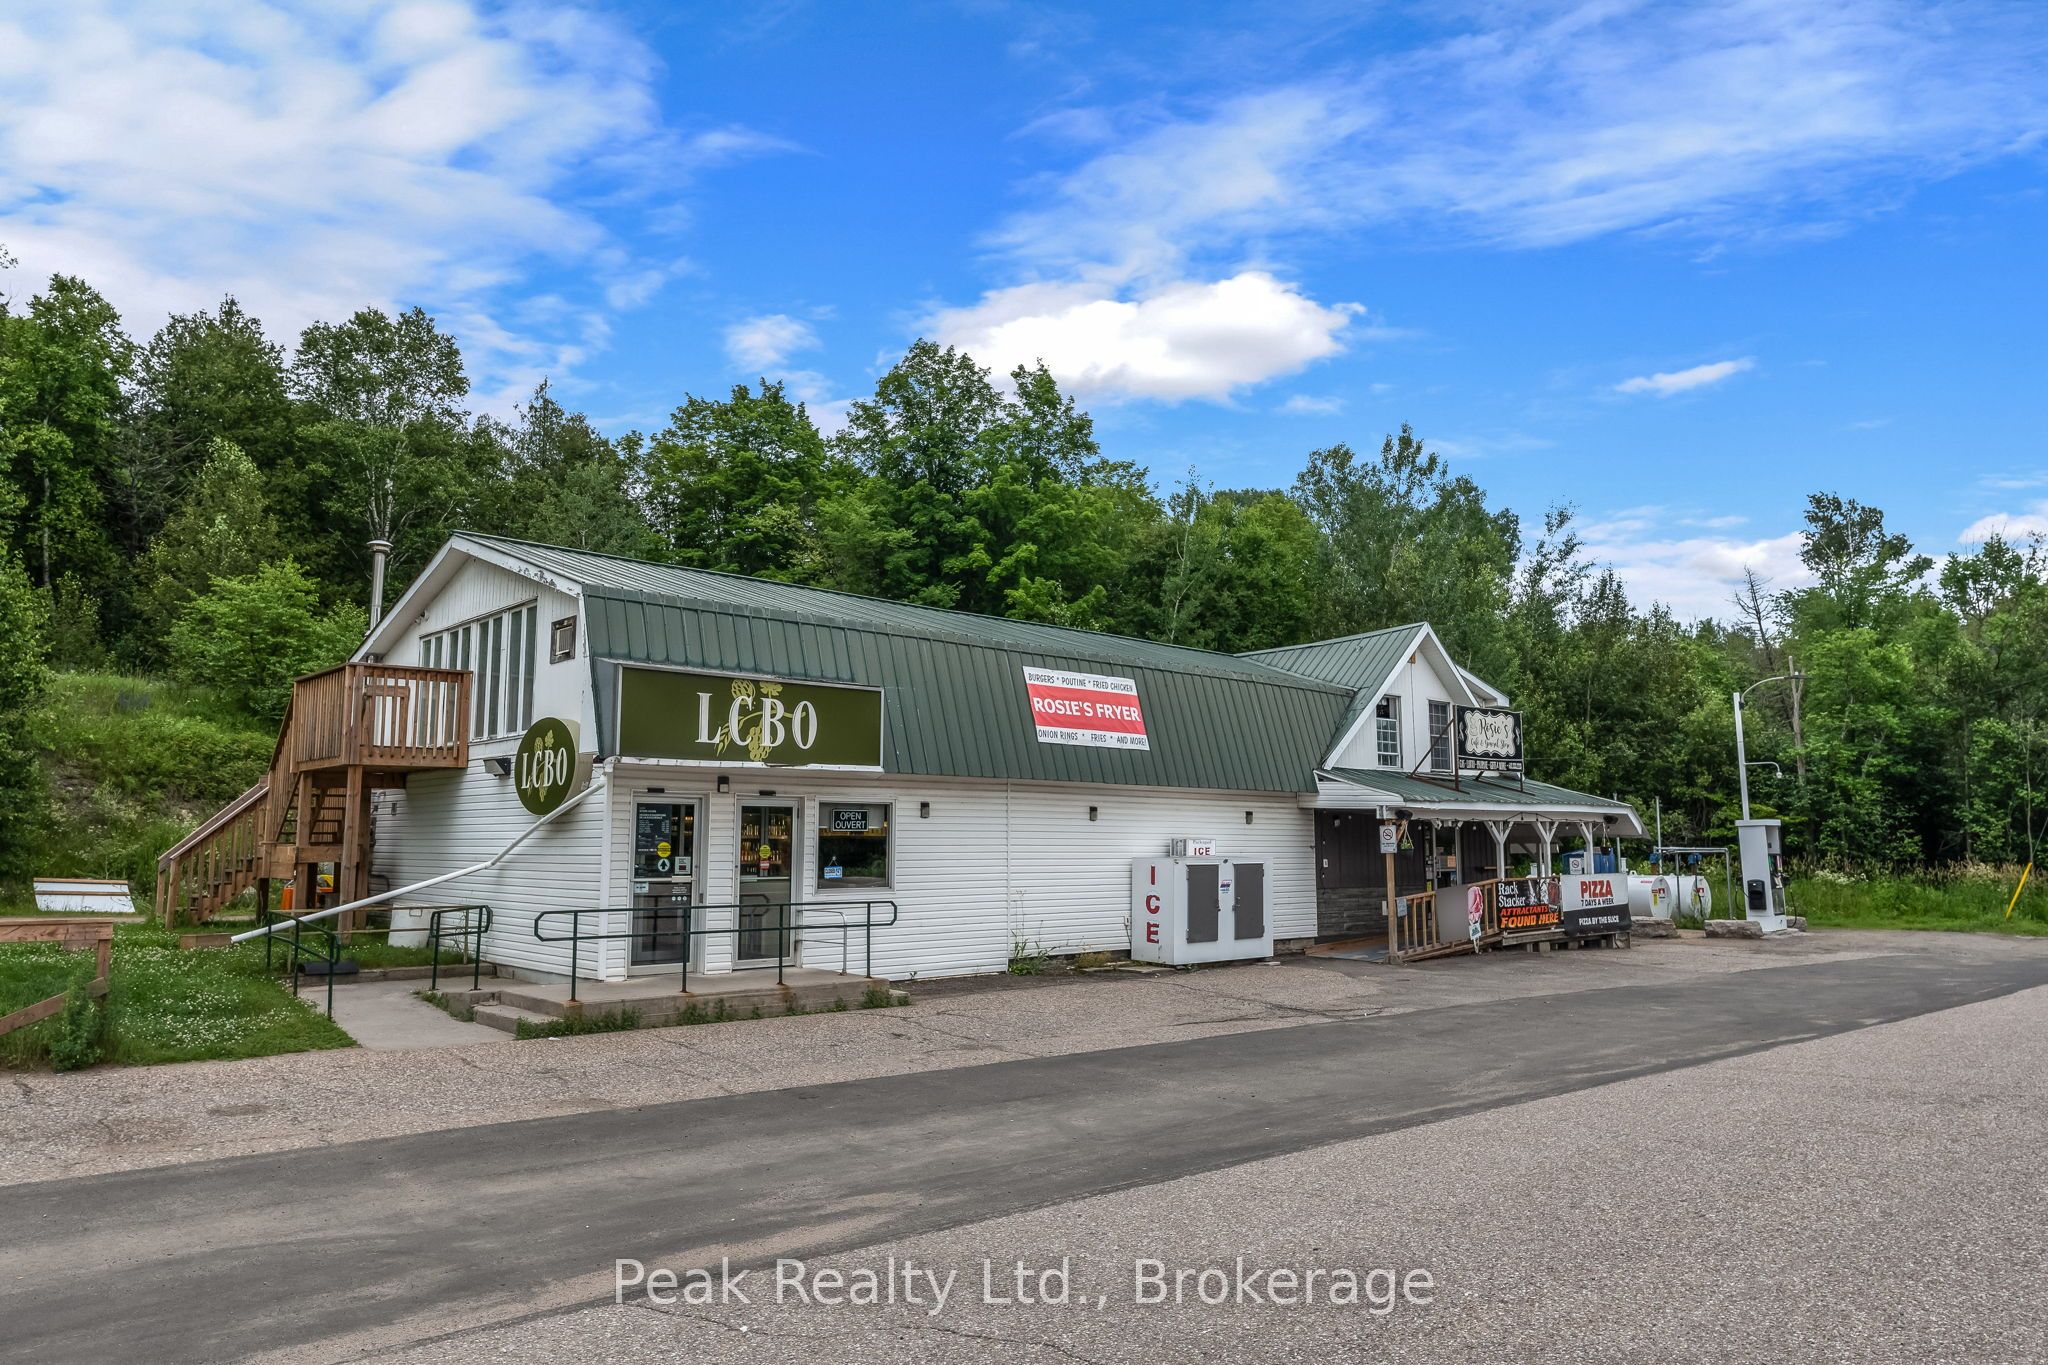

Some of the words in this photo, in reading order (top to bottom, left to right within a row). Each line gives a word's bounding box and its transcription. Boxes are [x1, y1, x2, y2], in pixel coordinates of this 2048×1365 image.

[1028, 673, 1054, 683] BURGERS
[1061, 677, 1086, 687] POUTINE
[1093, 681, 1109, 690] FRIED
[1110, 682, 1133, 692] CHICKEN
[1033, 697, 1094, 717] ROSIE'S
[1095, 703, 1141, 722] FRYER
[695, 692, 818, 750] LCBO
[1479, 718, 1509, 740] Rosie's
[1038, 729, 1058, 739] ONION
[1060, 732, 1079, 741] RINGS
[1091, 733, 1107, 743] FRIES
[1117, 736, 1128, 745] AND
[521, 747, 568, 789] LCBO
[840, 812, 862, 820] OPEN
[835, 820, 866, 829] OUVERT
[1194, 847, 1210, 856] ICE
[1498, 881, 1518, 895] Rack
[1580, 880, 1613, 899] PIZZA
[1146, 865, 1161, 944] ICE
[1498, 895, 1526, 907] Stacker
[1581, 899, 1584, 907] 7
[1585, 899, 1597, 907] DAYS
[1598, 898, 1601, 906] A
[1501, 905, 1548, 916] ATTRACTANTS
[1501, 915, 1537, 928] FOUND
[1538, 912, 1559, 924] HERE
[1579, 917, 1591, 925] PIZZA
[1608, 915, 1619, 923] SLICE
